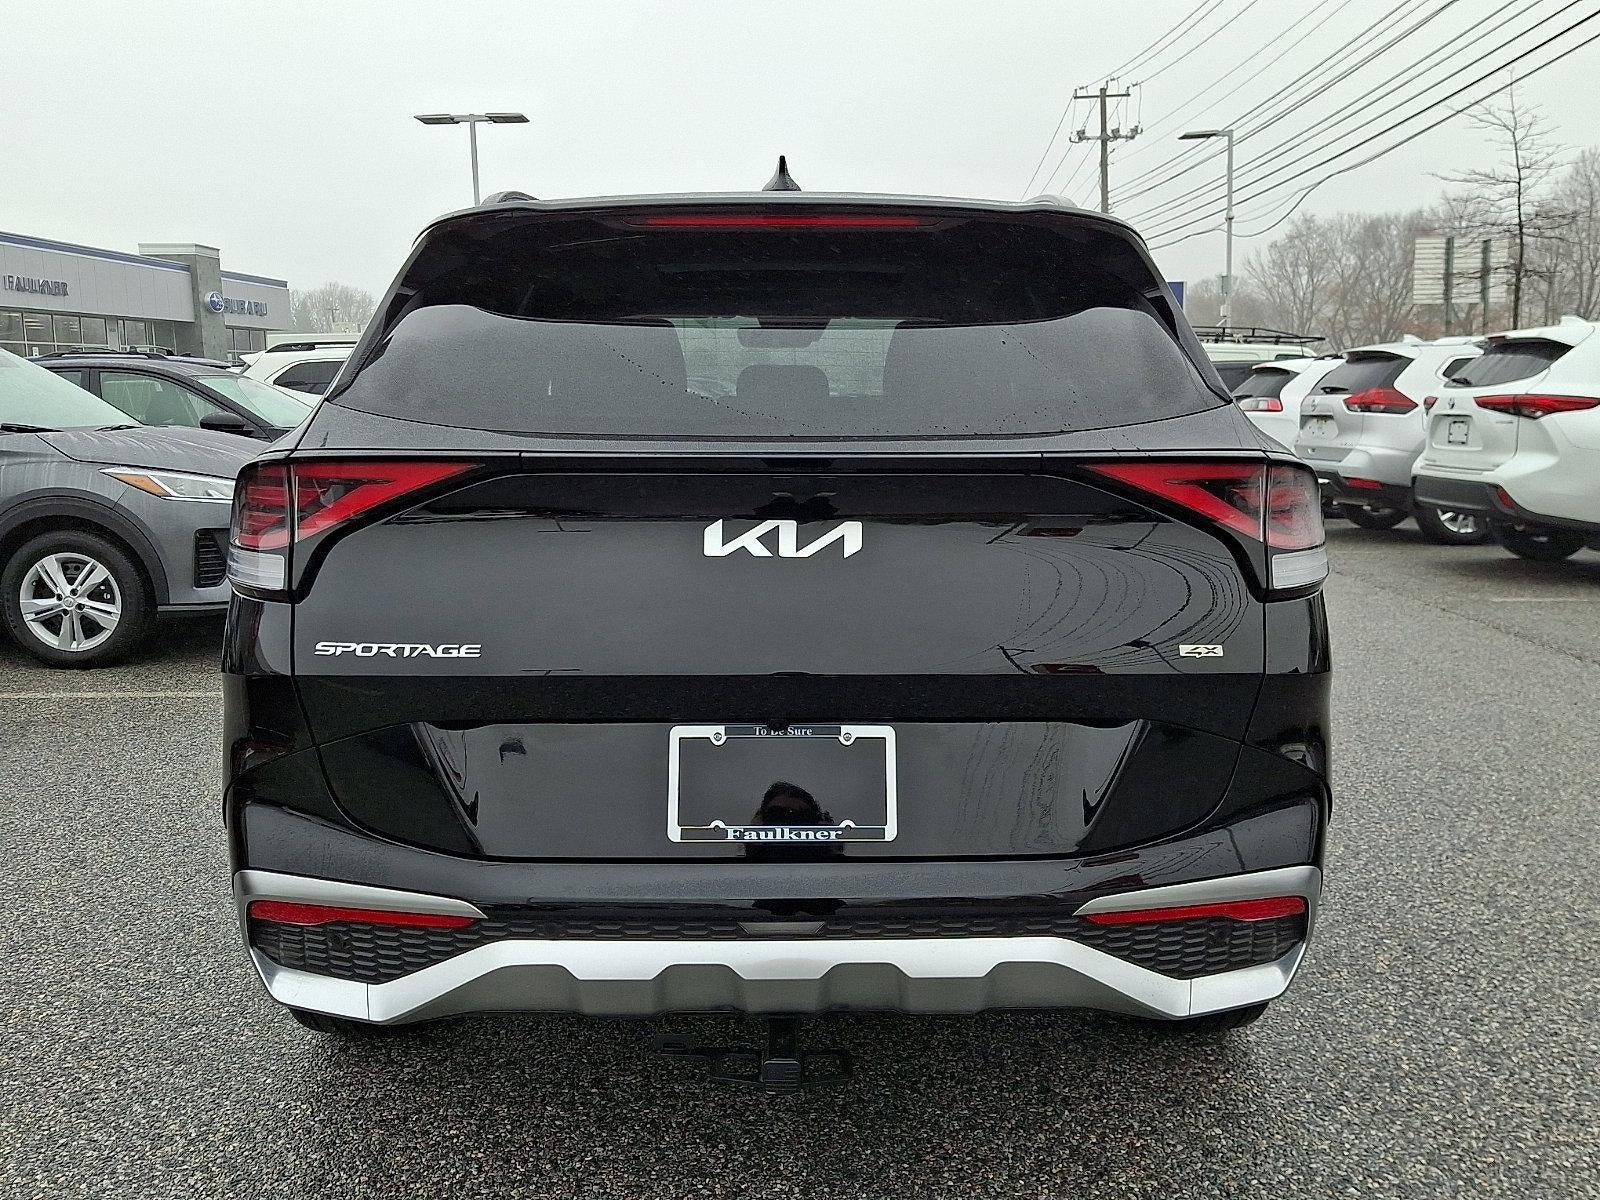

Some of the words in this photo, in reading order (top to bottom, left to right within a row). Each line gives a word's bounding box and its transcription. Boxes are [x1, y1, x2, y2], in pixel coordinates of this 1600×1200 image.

[4, 275, 69, 297] FAULKNER
[223, 297, 268, 316] SUBARU
[703, 518, 863, 559] KIA
[314, 641, 482, 658] SPORTAGE
[753, 726, 767, 736] To
[787, 726, 813, 736] Sure
[726, 827, 843, 840] Faulkner
